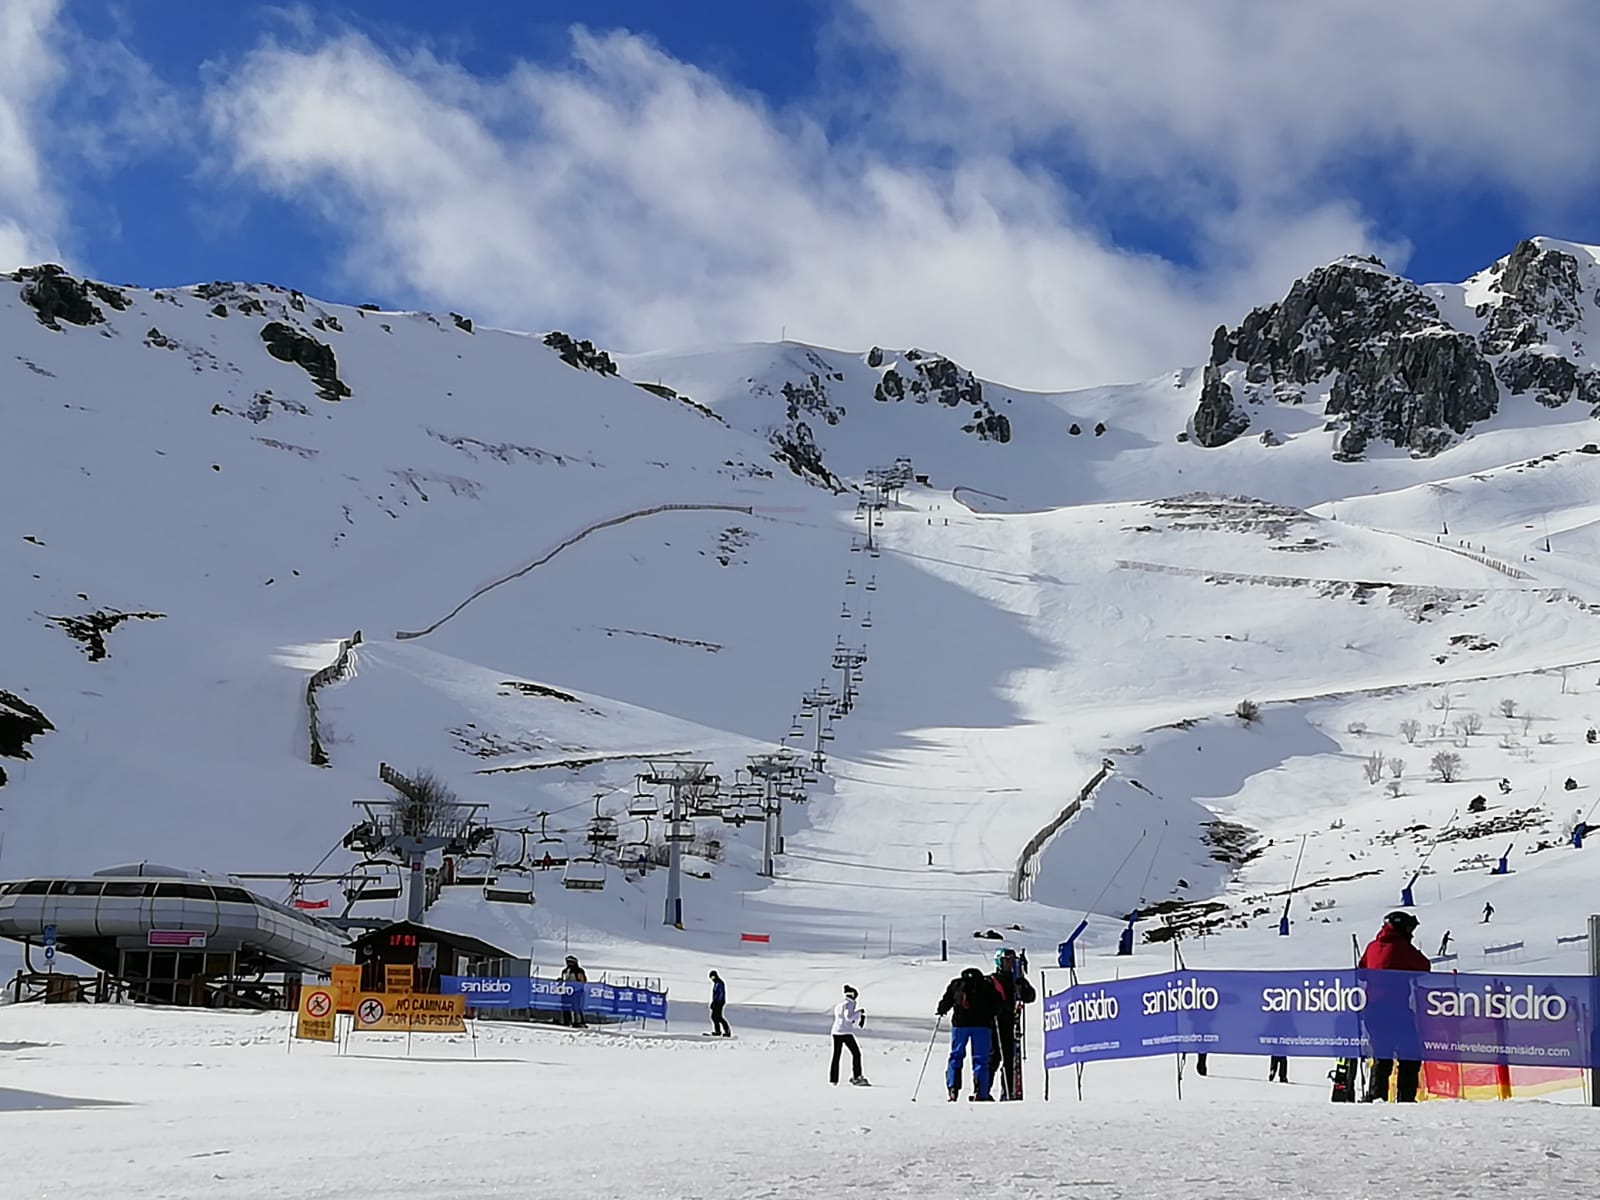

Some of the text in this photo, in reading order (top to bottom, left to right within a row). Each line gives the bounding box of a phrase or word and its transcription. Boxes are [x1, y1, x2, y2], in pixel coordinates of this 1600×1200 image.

[387, 1012, 461, 1026] POR LAS PISTAS
[1423, 1040, 1571, 1057] www.nieveleonsanisidro.com
